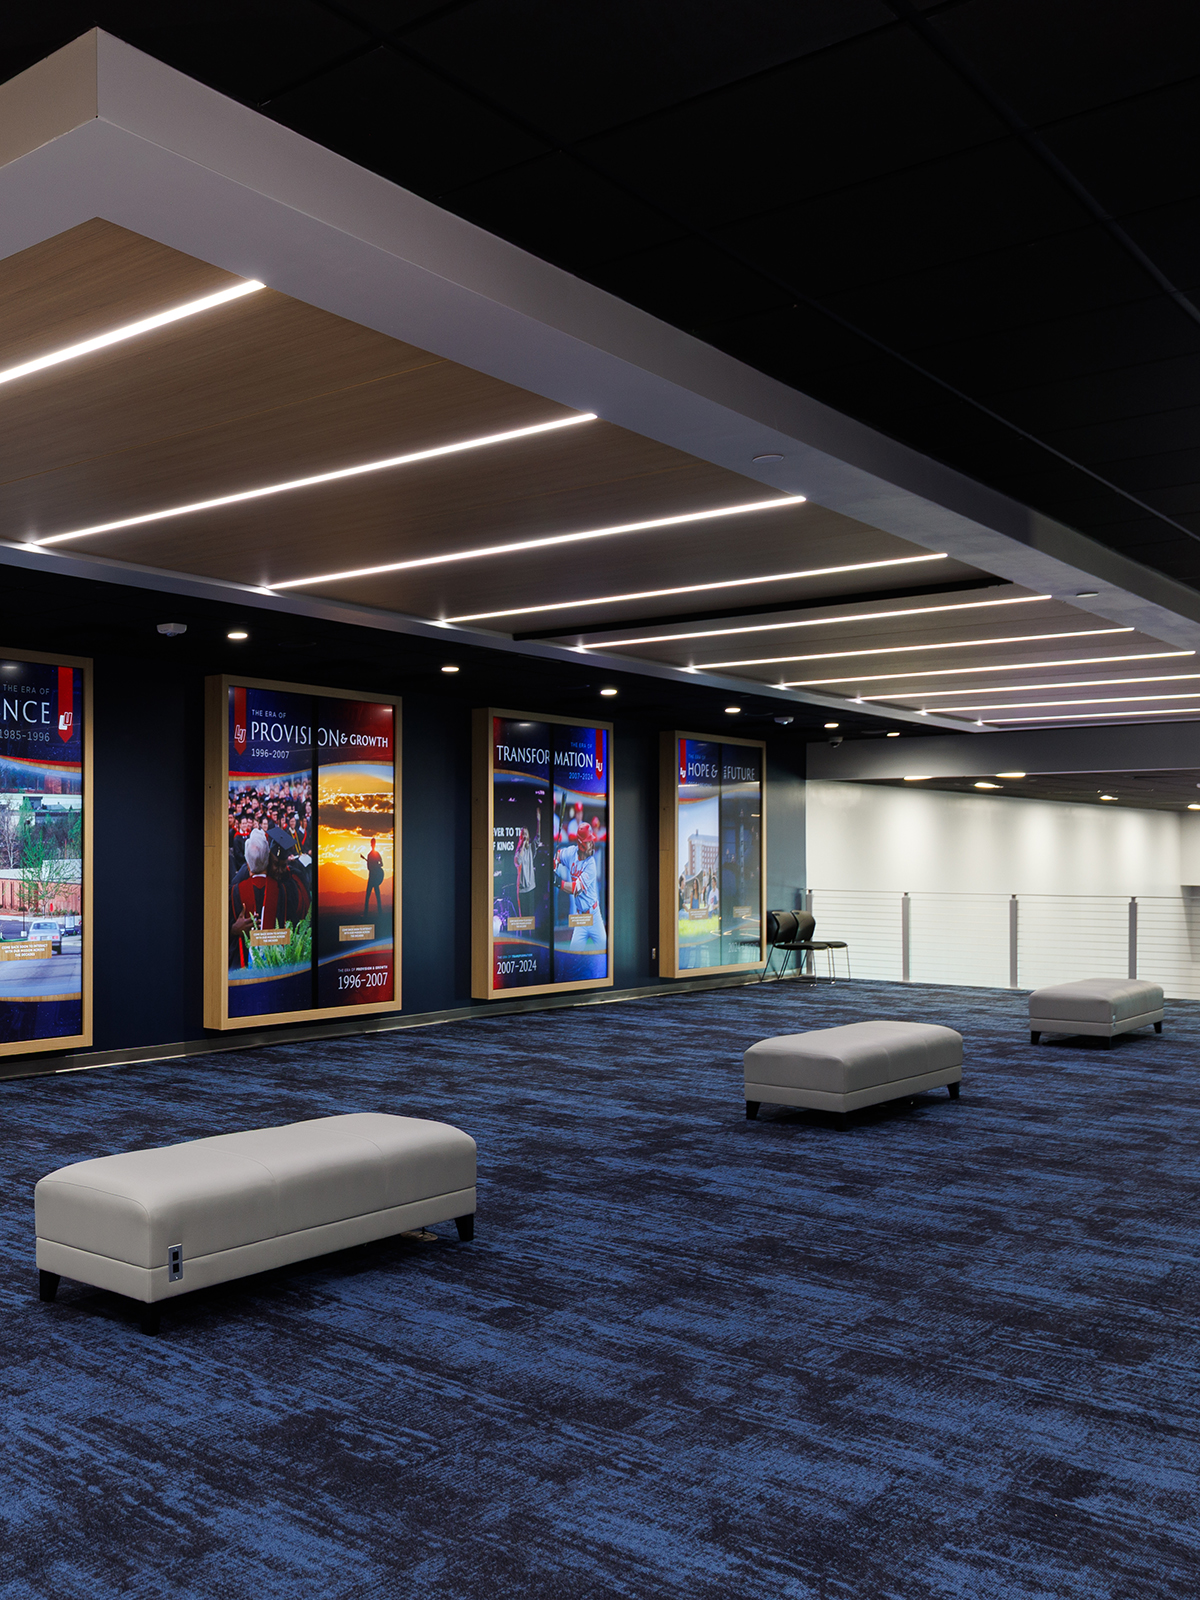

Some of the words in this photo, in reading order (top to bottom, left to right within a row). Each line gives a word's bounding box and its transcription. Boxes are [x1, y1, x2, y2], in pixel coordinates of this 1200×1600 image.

[3, 684, 18, 692] THE
[21, 686, 36, 694] ERA
[39, 688, 50, 696] OF
[340, 732, 348, 744] &
[350, 734, 388, 748] GROWTH
[252, 748, 290, 758] 1996-2007
[688, 762, 710, 778] HOPE
[711, 764, 718, 778] &
[728, 766, 756, 780] FUTURE
[505, 827, 514, 836] TO
[496, 842, 514, 850] KINGS
[496, 960, 537, 974] 2007-2024
[338, 972, 388, 990] 1996-2007
